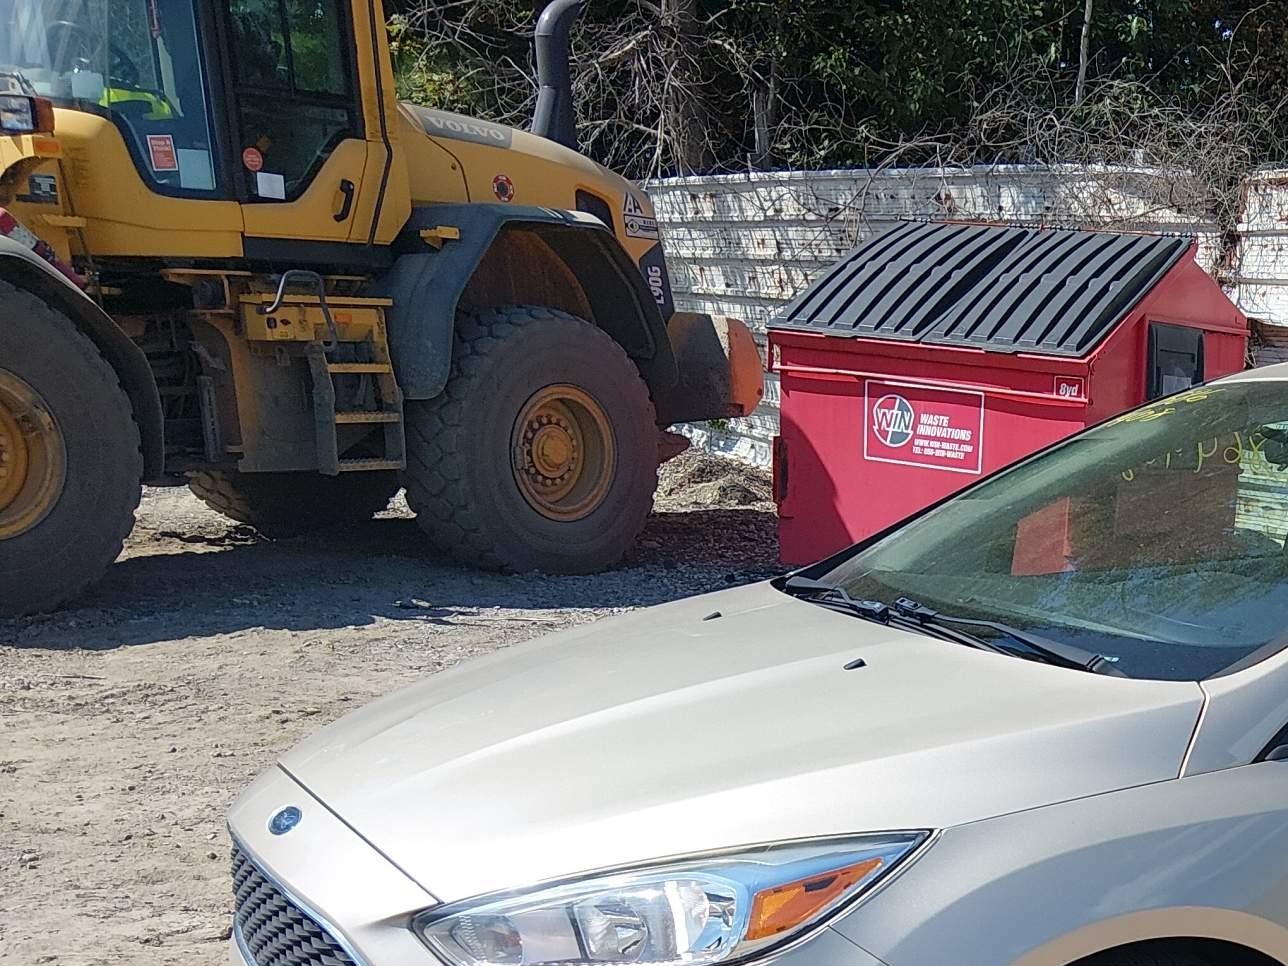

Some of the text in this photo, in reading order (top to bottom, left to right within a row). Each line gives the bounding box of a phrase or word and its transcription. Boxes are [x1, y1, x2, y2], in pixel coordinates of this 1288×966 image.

[425, 116, 504, 140] VOLVO
[647, 264, 665, 305] L90G
[1060, 383, 1079, 398] 8yd
[877, 408, 911, 433] WIN
[919, 413, 949, 427] WASTE
[916, 424, 972, 441] INNOVATIONS
